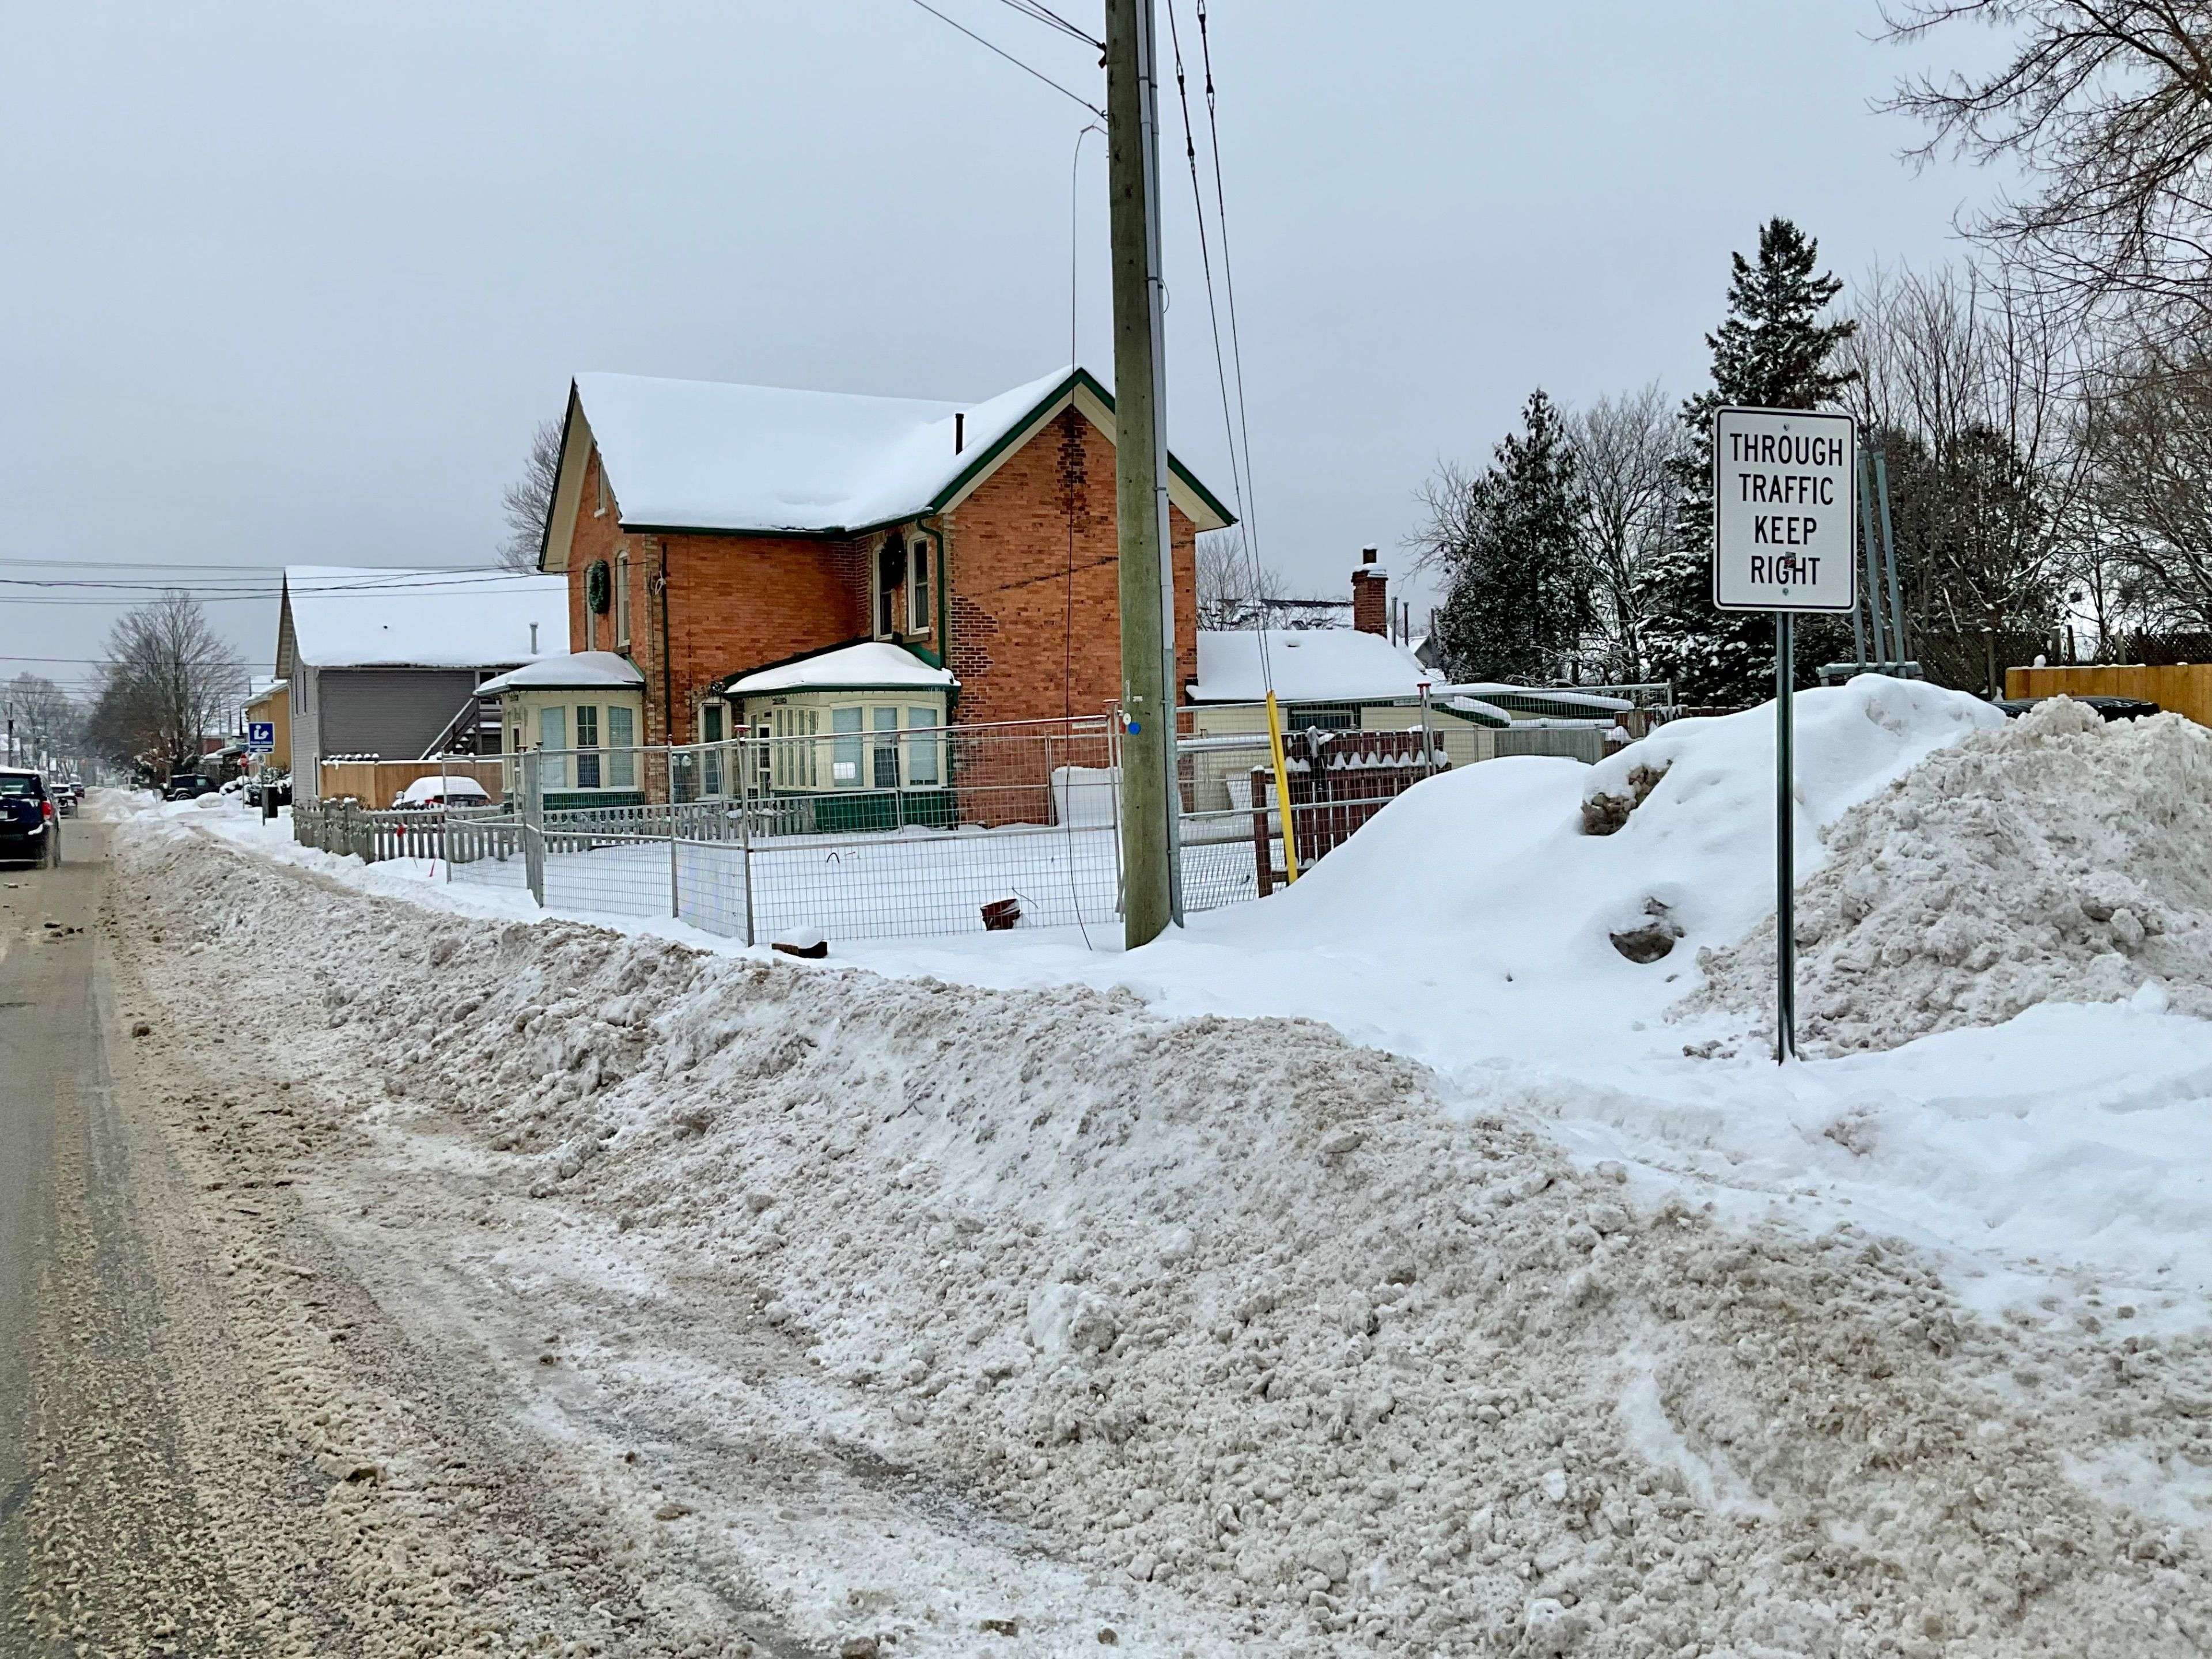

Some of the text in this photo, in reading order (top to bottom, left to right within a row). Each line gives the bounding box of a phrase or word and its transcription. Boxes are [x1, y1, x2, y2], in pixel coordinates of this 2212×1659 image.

[1730, 433, 1842, 466] THROUGH
[1738, 474, 1834, 505] TRAFFIC
[1755, 516, 1817, 545] KEEP
[1751, 556, 1820, 585] RIGHT
